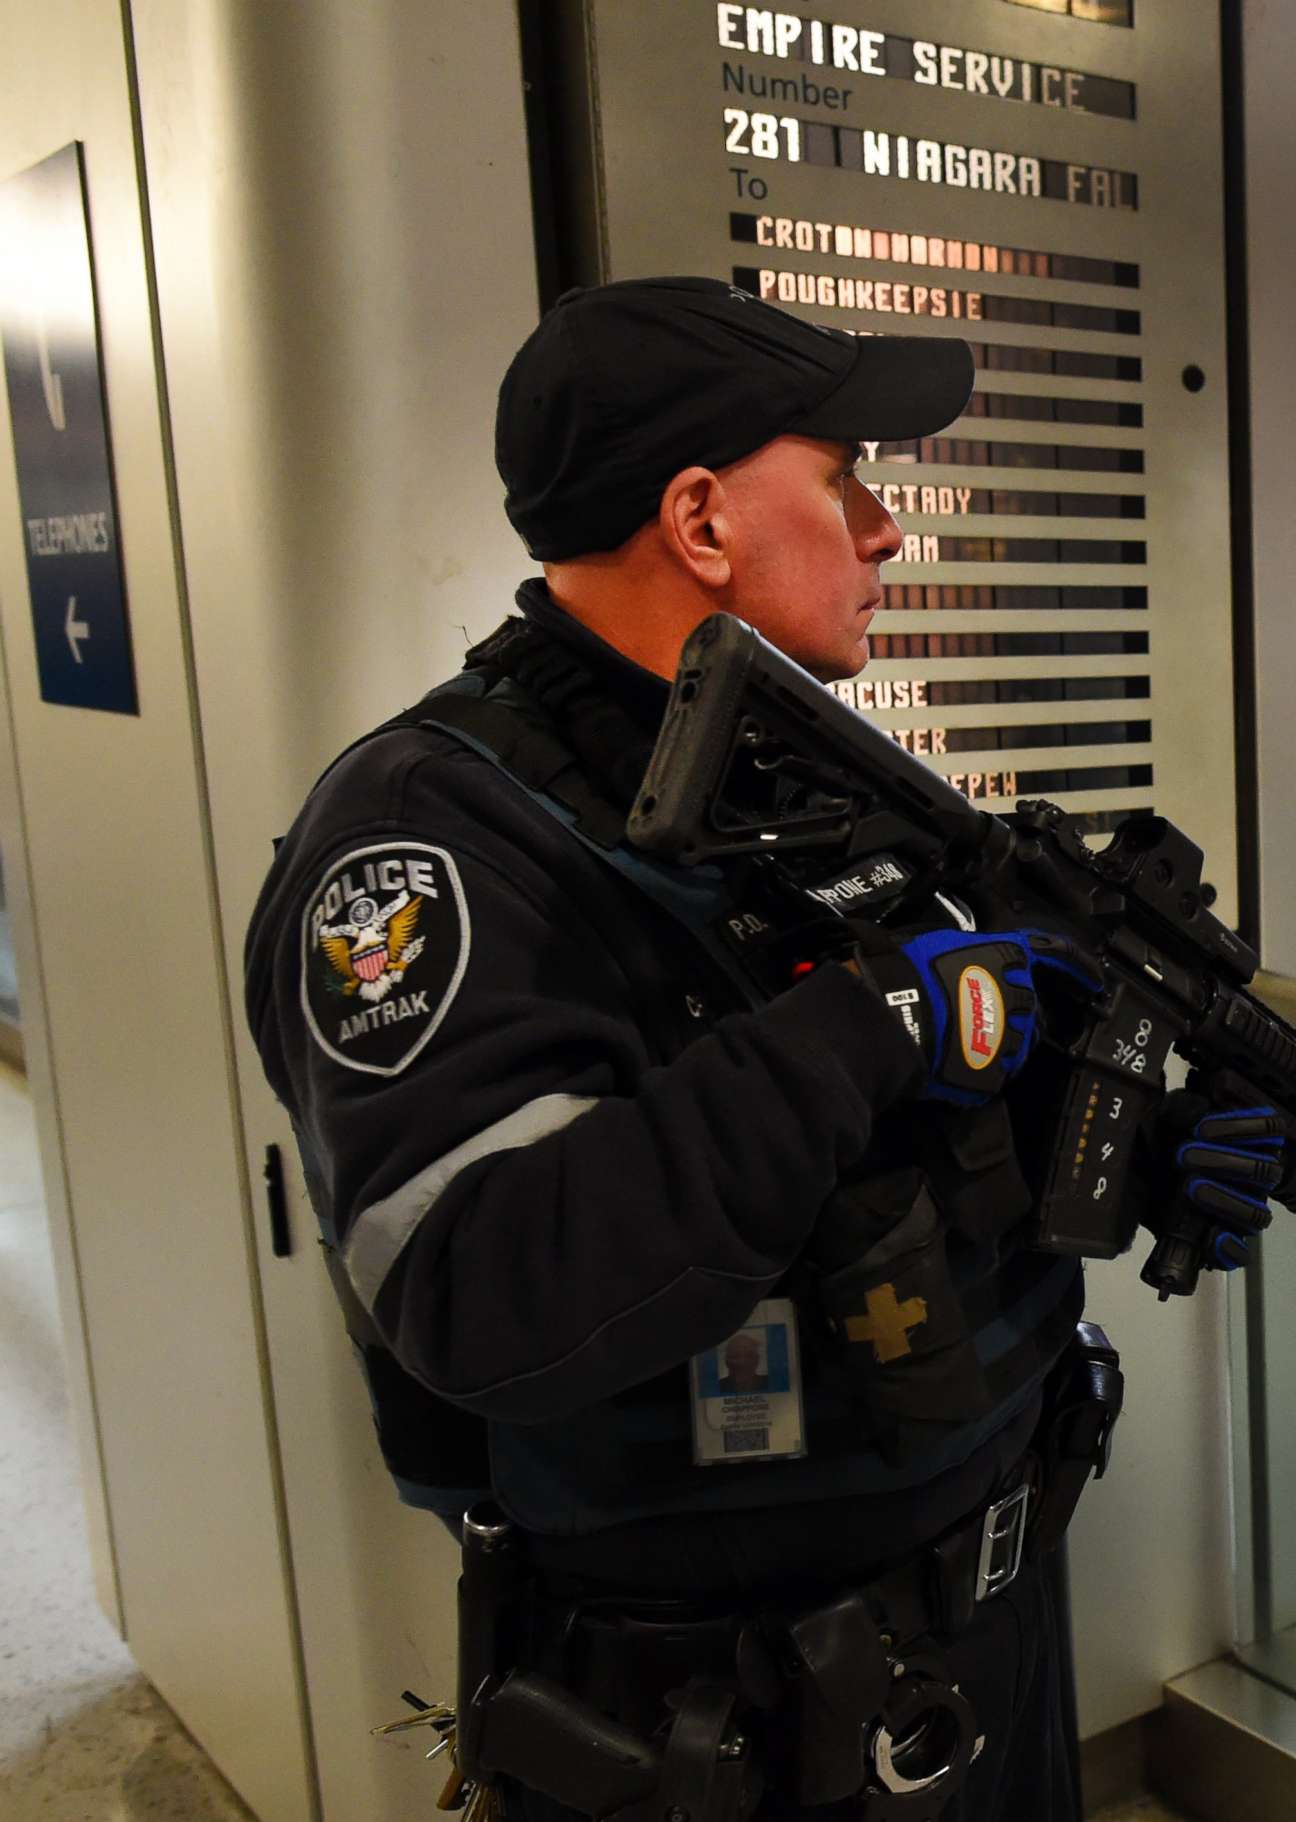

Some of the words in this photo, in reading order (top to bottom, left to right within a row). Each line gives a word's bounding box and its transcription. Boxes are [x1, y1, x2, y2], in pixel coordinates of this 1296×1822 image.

[717, 2, 886, 76] EMPIRE
[912, 41, 1086, 112] SERVICE
[722, 62, 853, 110] Number
[724, 107, 800, 162] 281
[863, 130, 1041, 198] NIAGARA
[729, 168, 768, 200] To
[759, 269, 982, 320] POUGHKEEPSIE
[312, 860, 439, 953] POLICE
[338, 990, 430, 1045] AMTRAK
[1112, 1038, 1147, 1073] 348
[1109, 1097, 1123, 1120] 3
[1101, 1142, 1114, 1161] 4
[1093, 1176, 1108, 1200] 8
